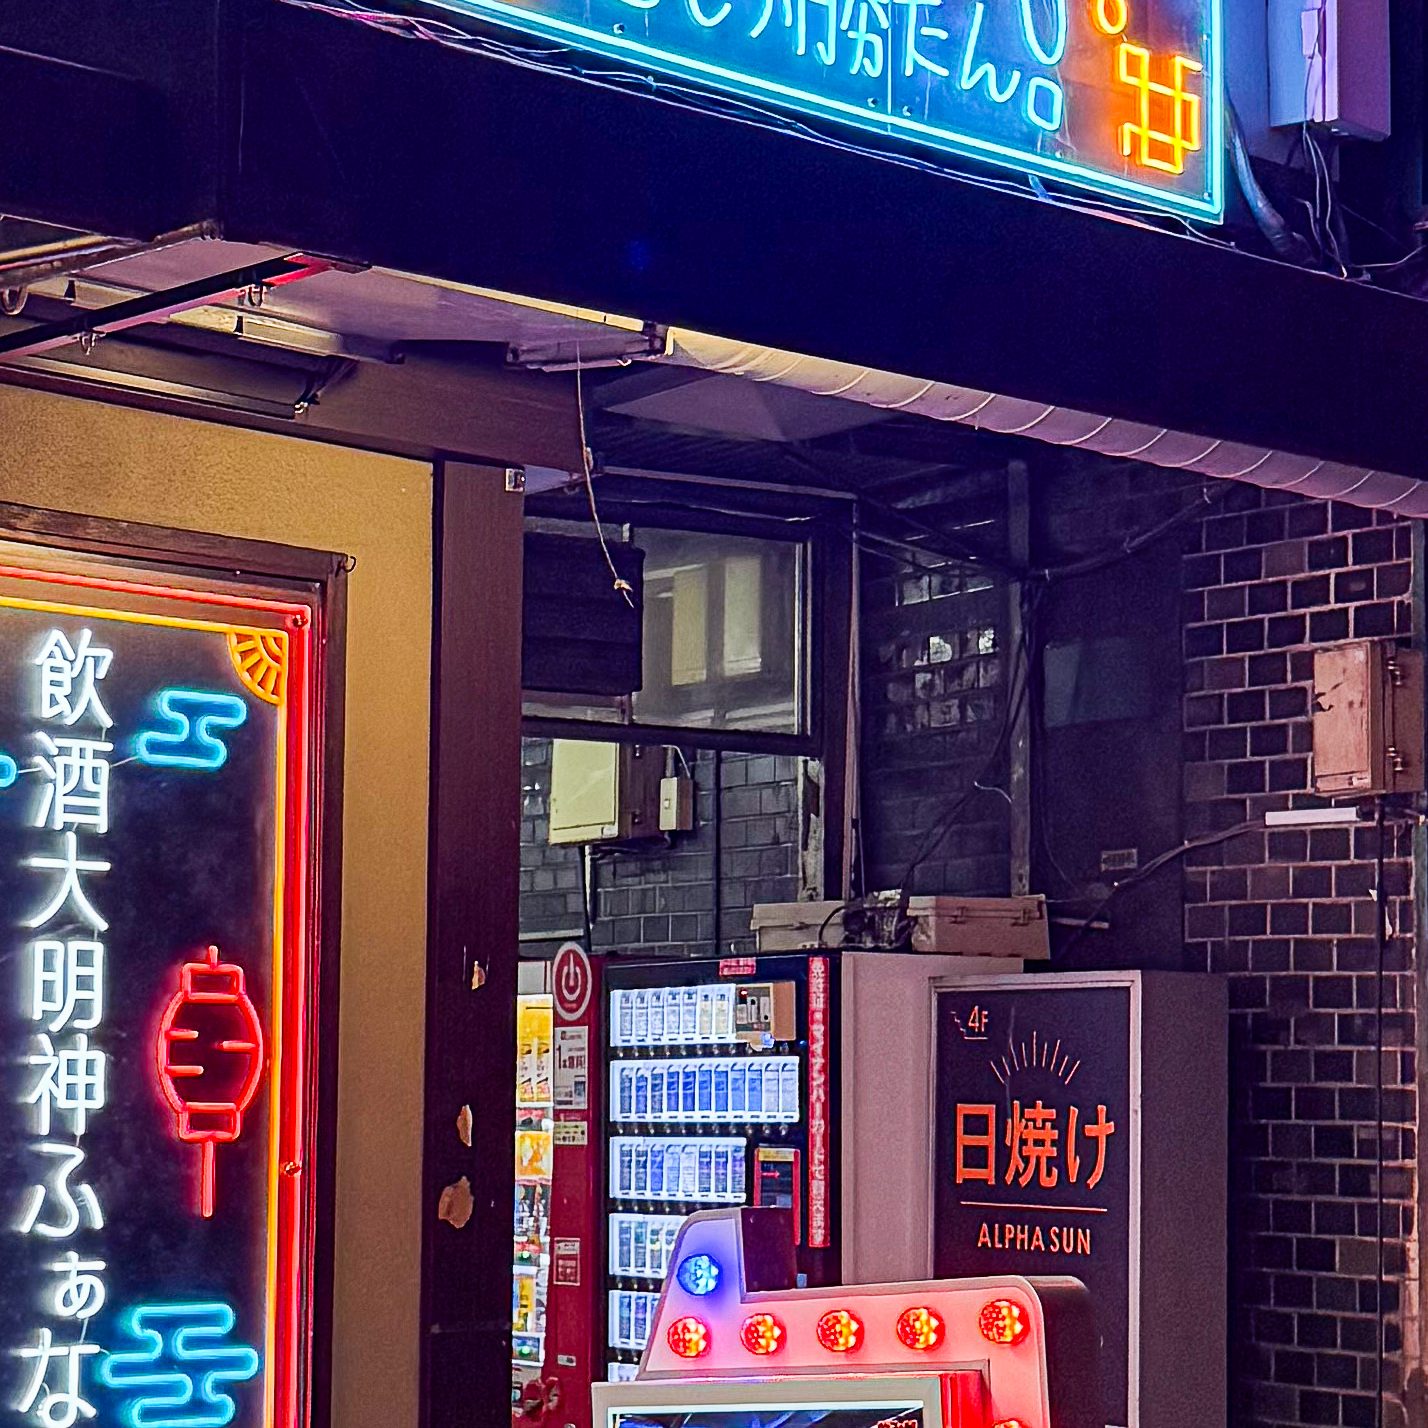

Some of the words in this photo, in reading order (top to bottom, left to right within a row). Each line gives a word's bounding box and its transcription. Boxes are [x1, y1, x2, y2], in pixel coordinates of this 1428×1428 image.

[968, 1005, 989, 1033] 4F
[956, 1100, 1116, 1190] 日焼け
